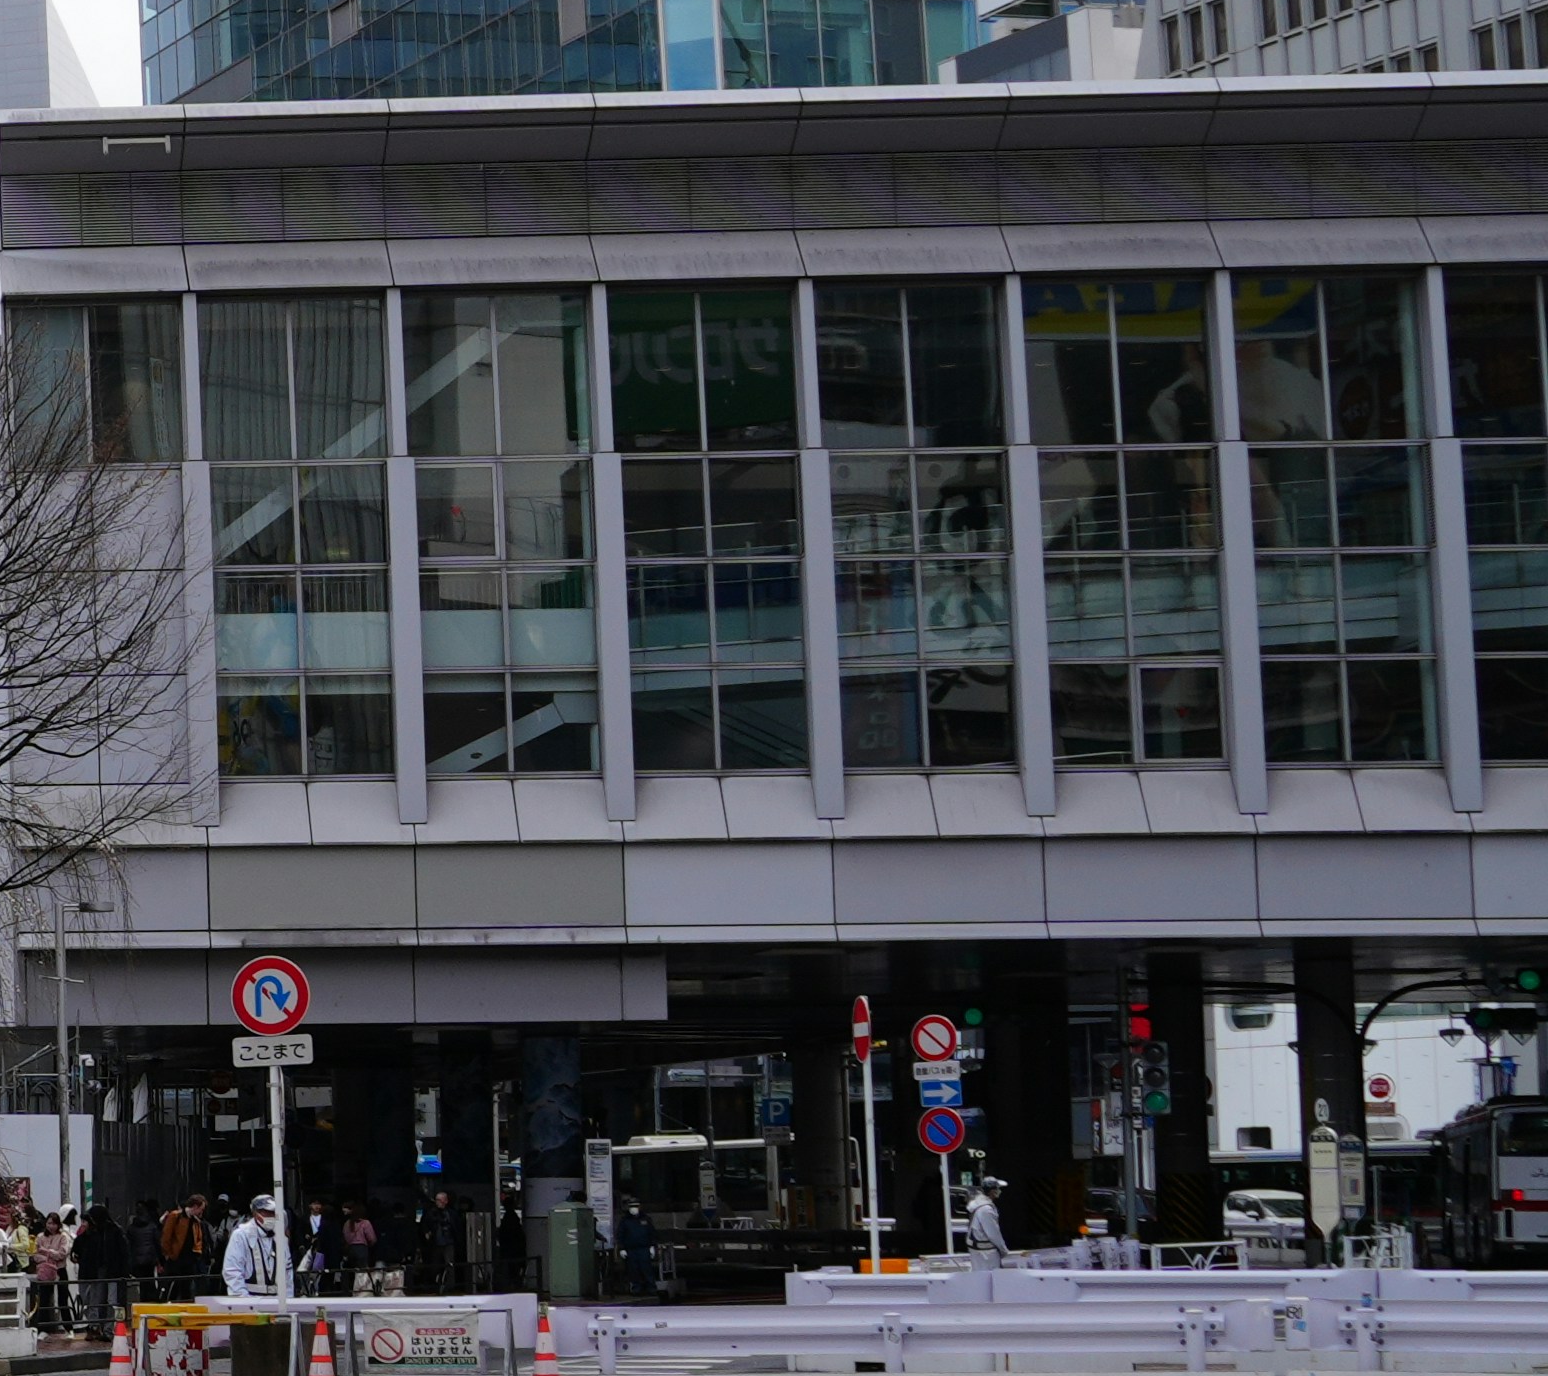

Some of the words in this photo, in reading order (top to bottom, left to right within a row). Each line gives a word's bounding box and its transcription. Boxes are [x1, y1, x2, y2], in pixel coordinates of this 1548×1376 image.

[239, 1043, 307, 1062] ここまで
[769, 1101, 786, 1124] P
[411, 1336, 473, 1346] はいっては
[411, 1346, 474, 1356] いけません
